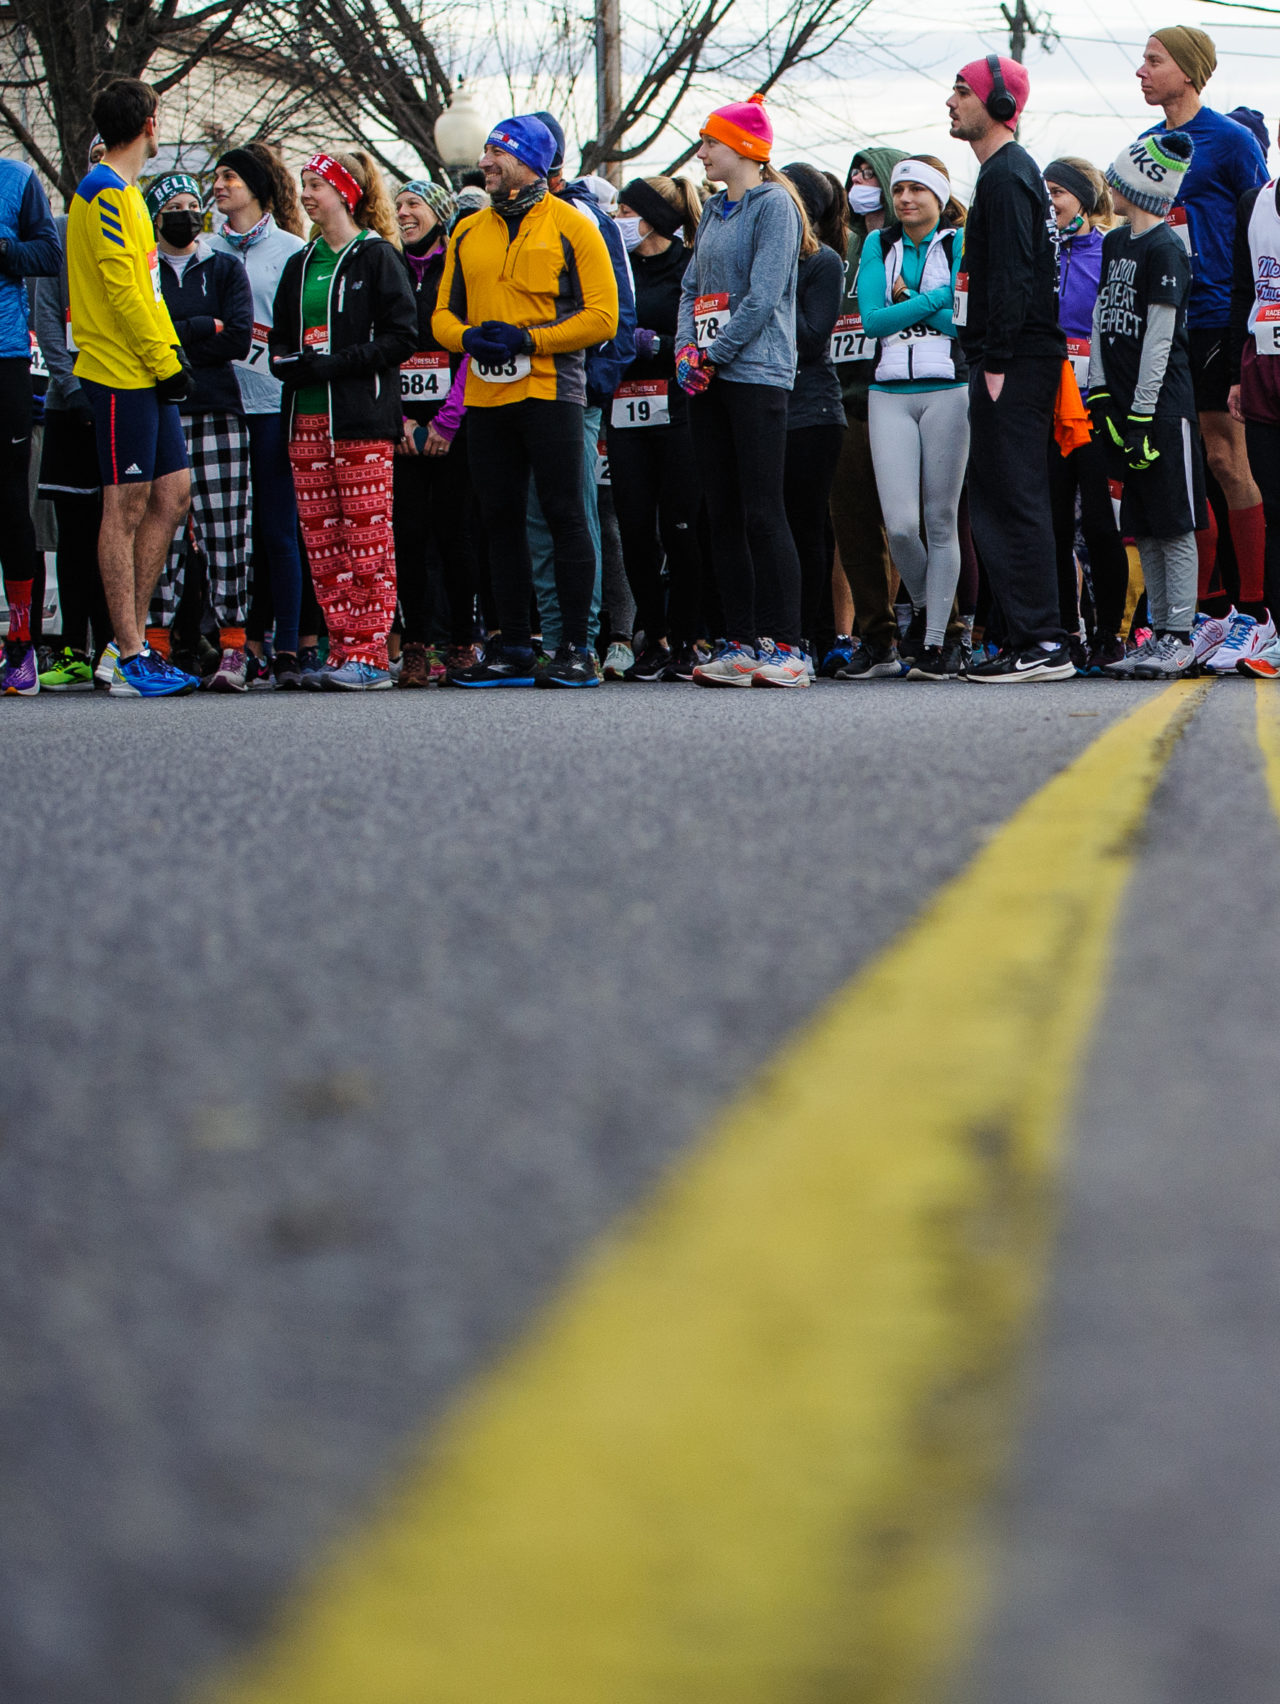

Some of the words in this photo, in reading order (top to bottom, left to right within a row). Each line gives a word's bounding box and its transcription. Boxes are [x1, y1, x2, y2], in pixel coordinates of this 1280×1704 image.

[833, 333, 866, 357] 727
[400, 373, 439, 395] 684
[626, 401, 651, 422] 19
